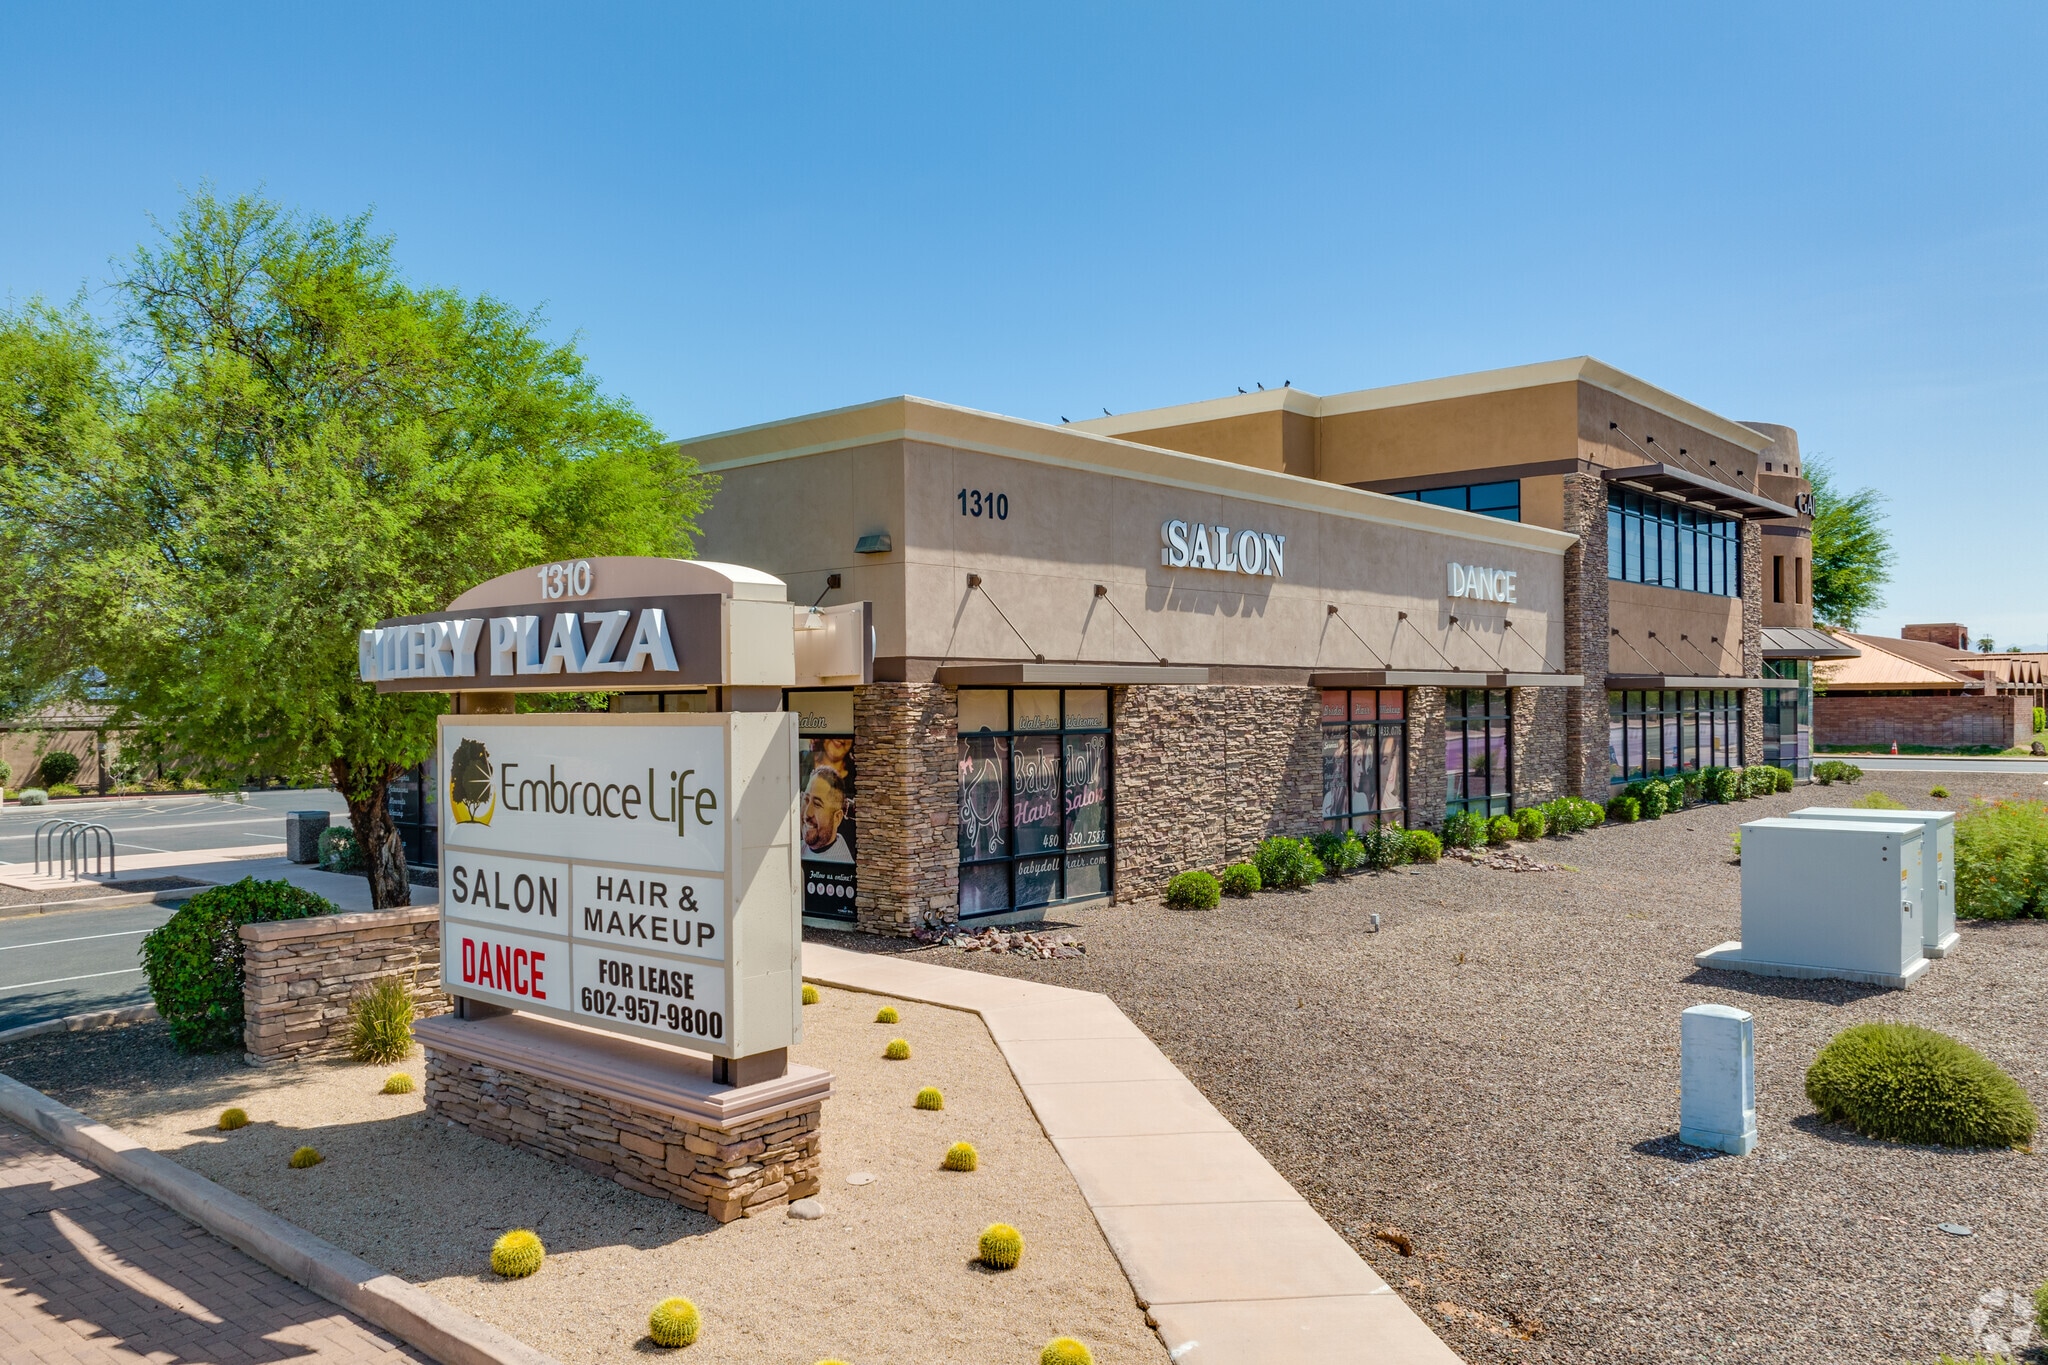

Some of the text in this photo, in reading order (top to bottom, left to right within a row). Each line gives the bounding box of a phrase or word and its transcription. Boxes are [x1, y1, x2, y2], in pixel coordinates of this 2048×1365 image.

[957, 488, 1009, 520] 1310
[1161, 519, 1287, 577] SALON
[538, 560, 591, 599] 1310
[1446, 562, 1517, 604] DANCE
[489, 608, 679, 676] PLAZA
[1065, 713, 1104, 728] Welcome!
[501, 763, 718, 837] Embrace Life
[1014, 785, 1106, 827] Hair Salon
[1042, 833, 1059, 849] 480
[452, 865, 558, 918] SALON
[597, 876, 699, 912] HAIR &
[584, 907, 715, 948] MAKEUP
[462, 937, 547, 1000] DANCE
[598, 959, 694, 1000] FOR LEASE
[581, 987, 723, 1039] 602-957-9800
